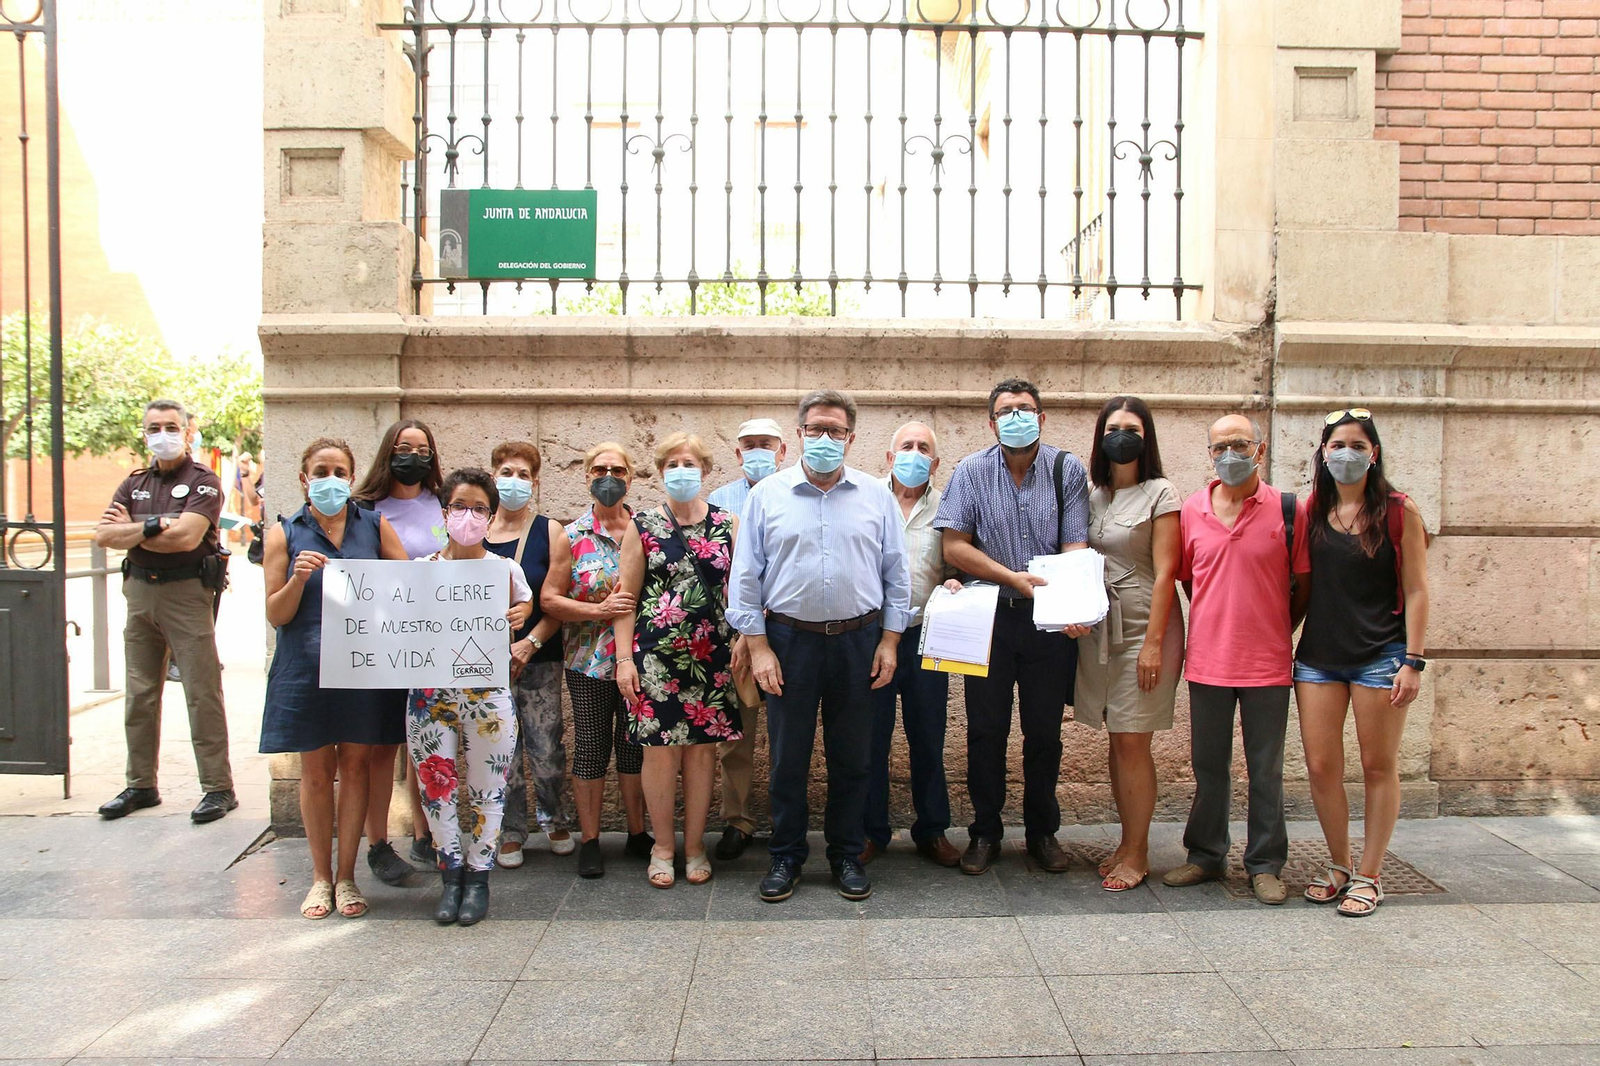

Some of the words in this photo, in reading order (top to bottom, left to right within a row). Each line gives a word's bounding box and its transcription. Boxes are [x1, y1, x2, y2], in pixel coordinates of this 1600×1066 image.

[482, 207, 514, 220] JUNTA
[518, 207, 531, 220] DE
[498, 261, 539, 269] DELEGACIÓN
[552, 262, 587, 270] GOBIERNO
[392, 587, 415, 603] AL
[435, 584, 495, 602] CIERRE
[345, 618, 369, 635] DE
[381, 620, 443, 634] NUESTRO
[450, 617, 507, 632] CENTRO
[351, 651, 376, 668] DE
[455, 666, 493, 675] CERRADO
